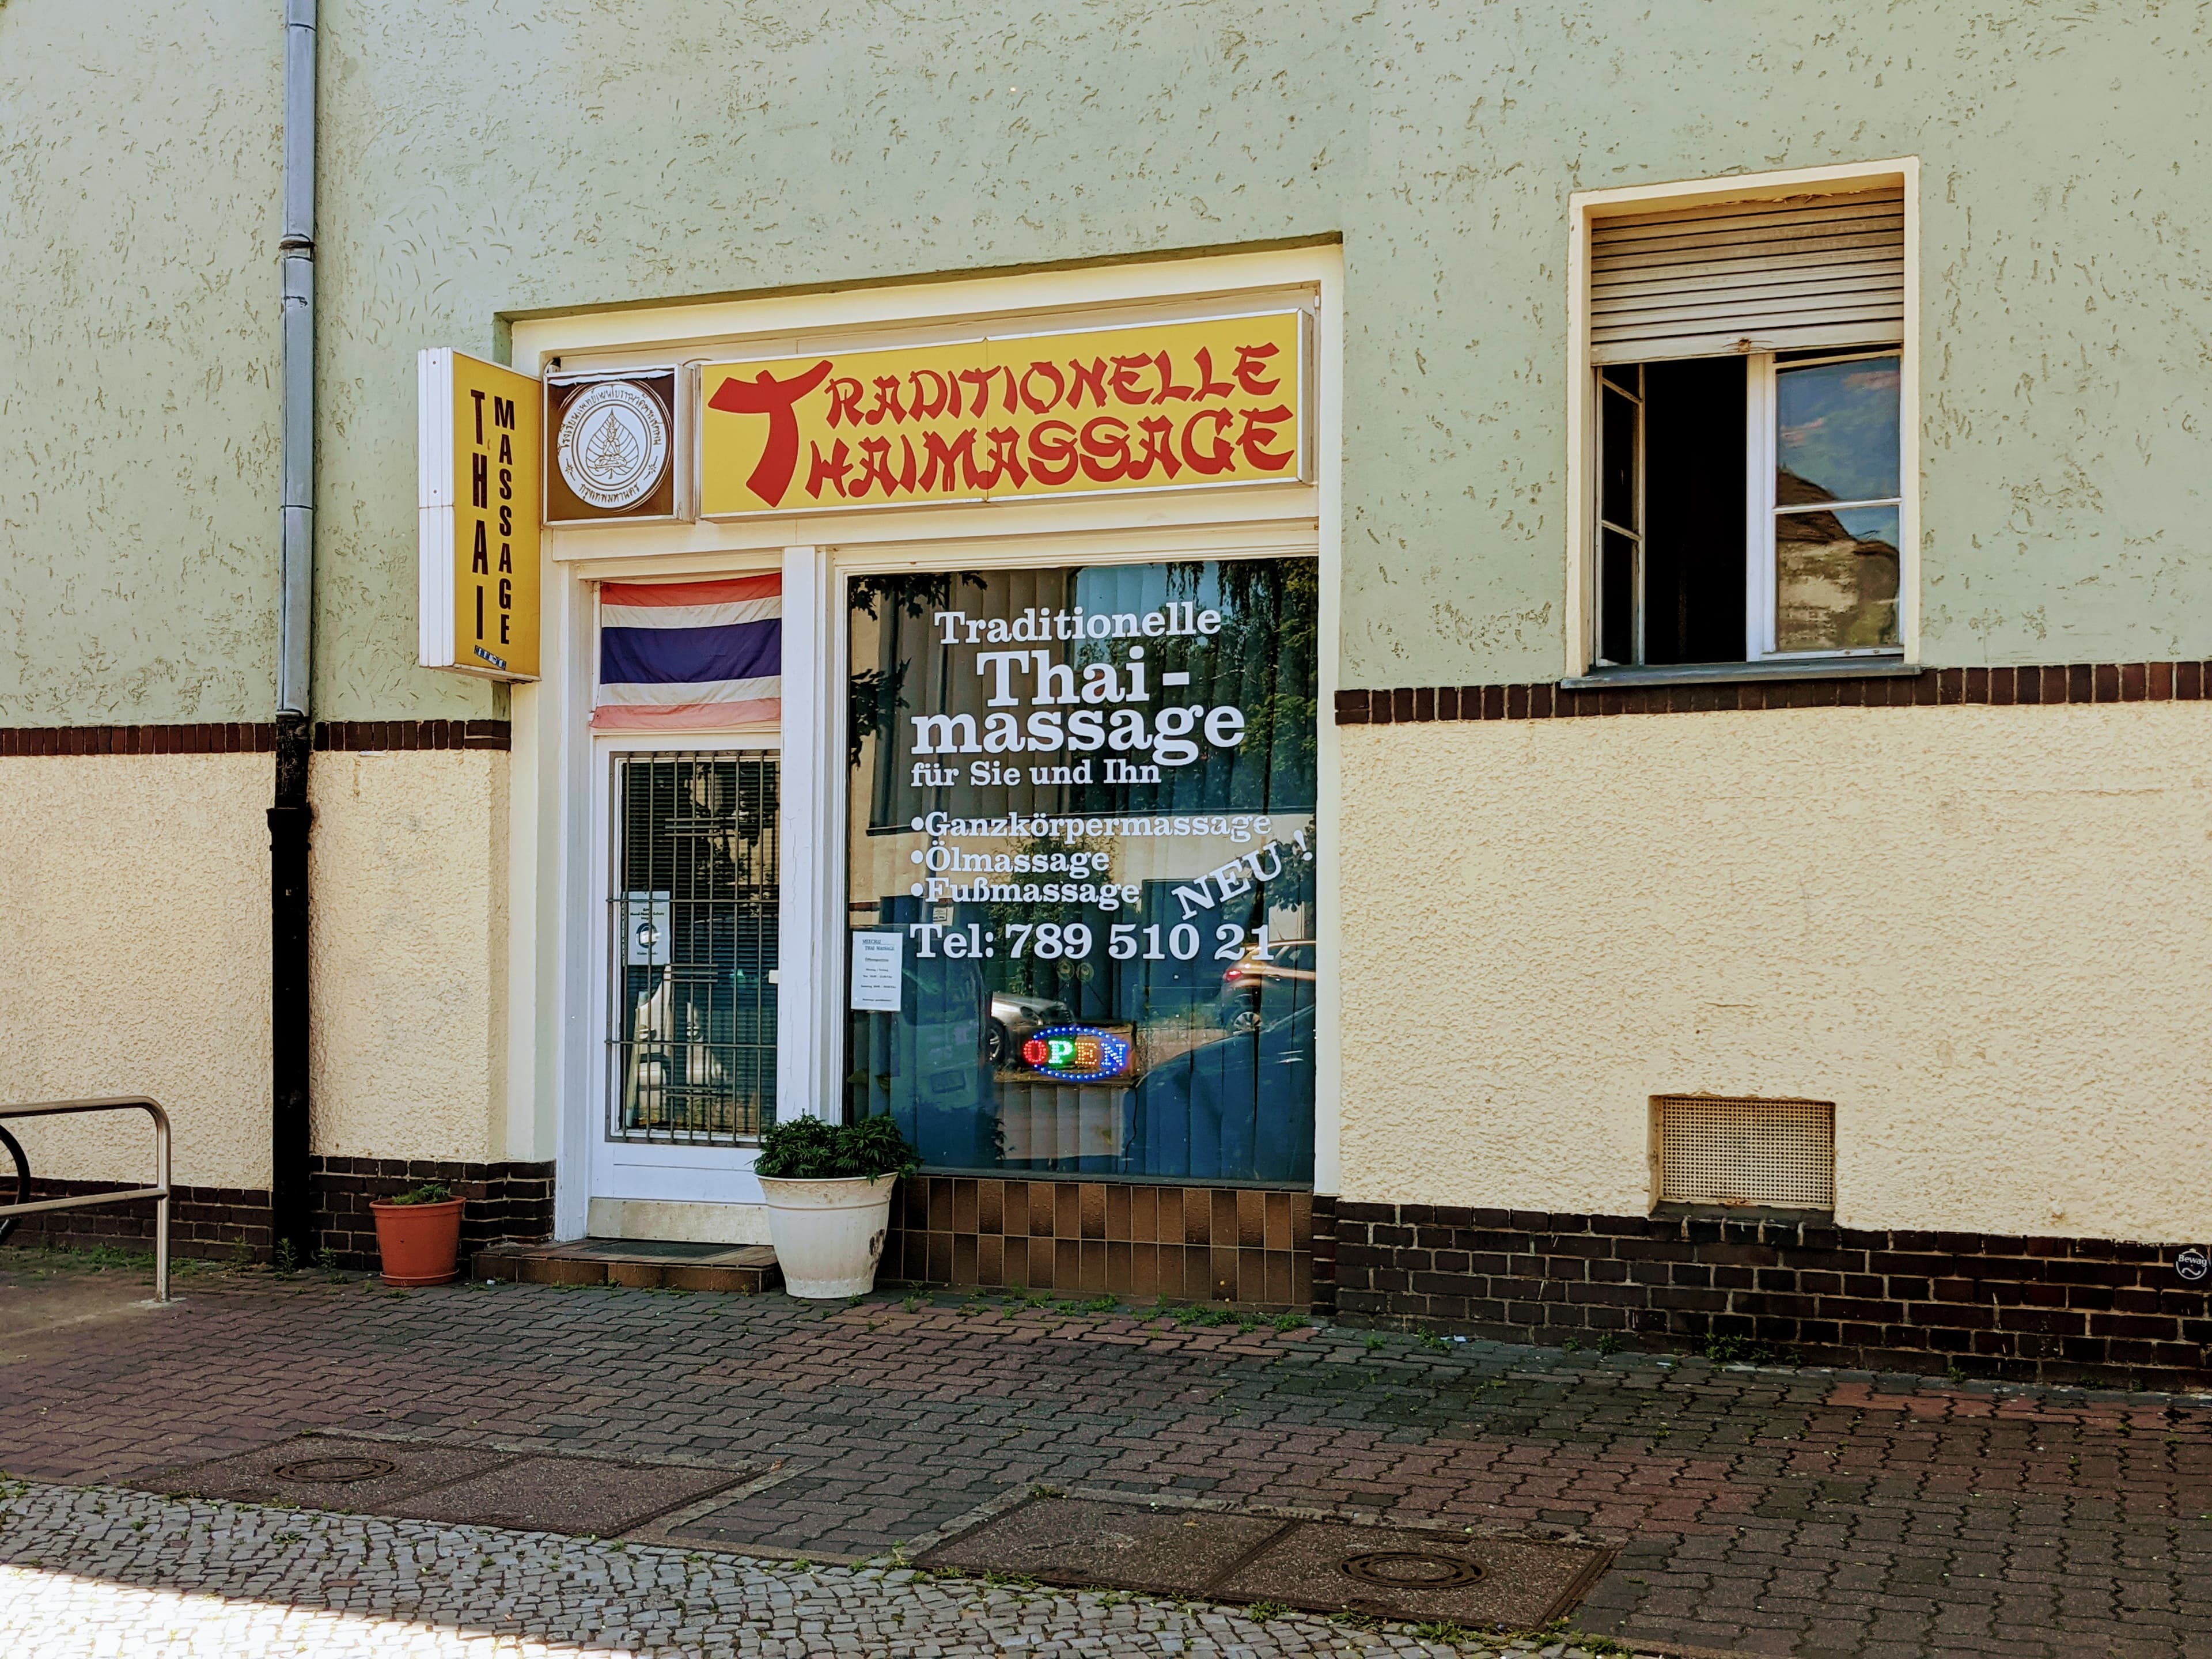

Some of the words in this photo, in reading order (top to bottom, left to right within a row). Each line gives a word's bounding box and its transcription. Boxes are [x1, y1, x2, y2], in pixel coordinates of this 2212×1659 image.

[471, 389, 488, 640] THAI
[494, 396, 514, 645] MASSAGE
[934, 601, 1221, 644] Traditionelle
[910, 704, 1245, 766] massage
[910, 762, 959, 787] für
[970, 760, 1021, 786] Sie
[1029, 759, 1093, 785] und
[1103, 758, 1161, 783] Ihn
[910, 923, 994, 959] Tel:
[1005, 923, 1093, 960] 789
[1108, 923, 1200, 960] 510
[1213, 923, 1275, 960] 21
[1023, 1039, 1126, 1066] OPEN
[2178, 1254, 2207, 1267] Bewag
